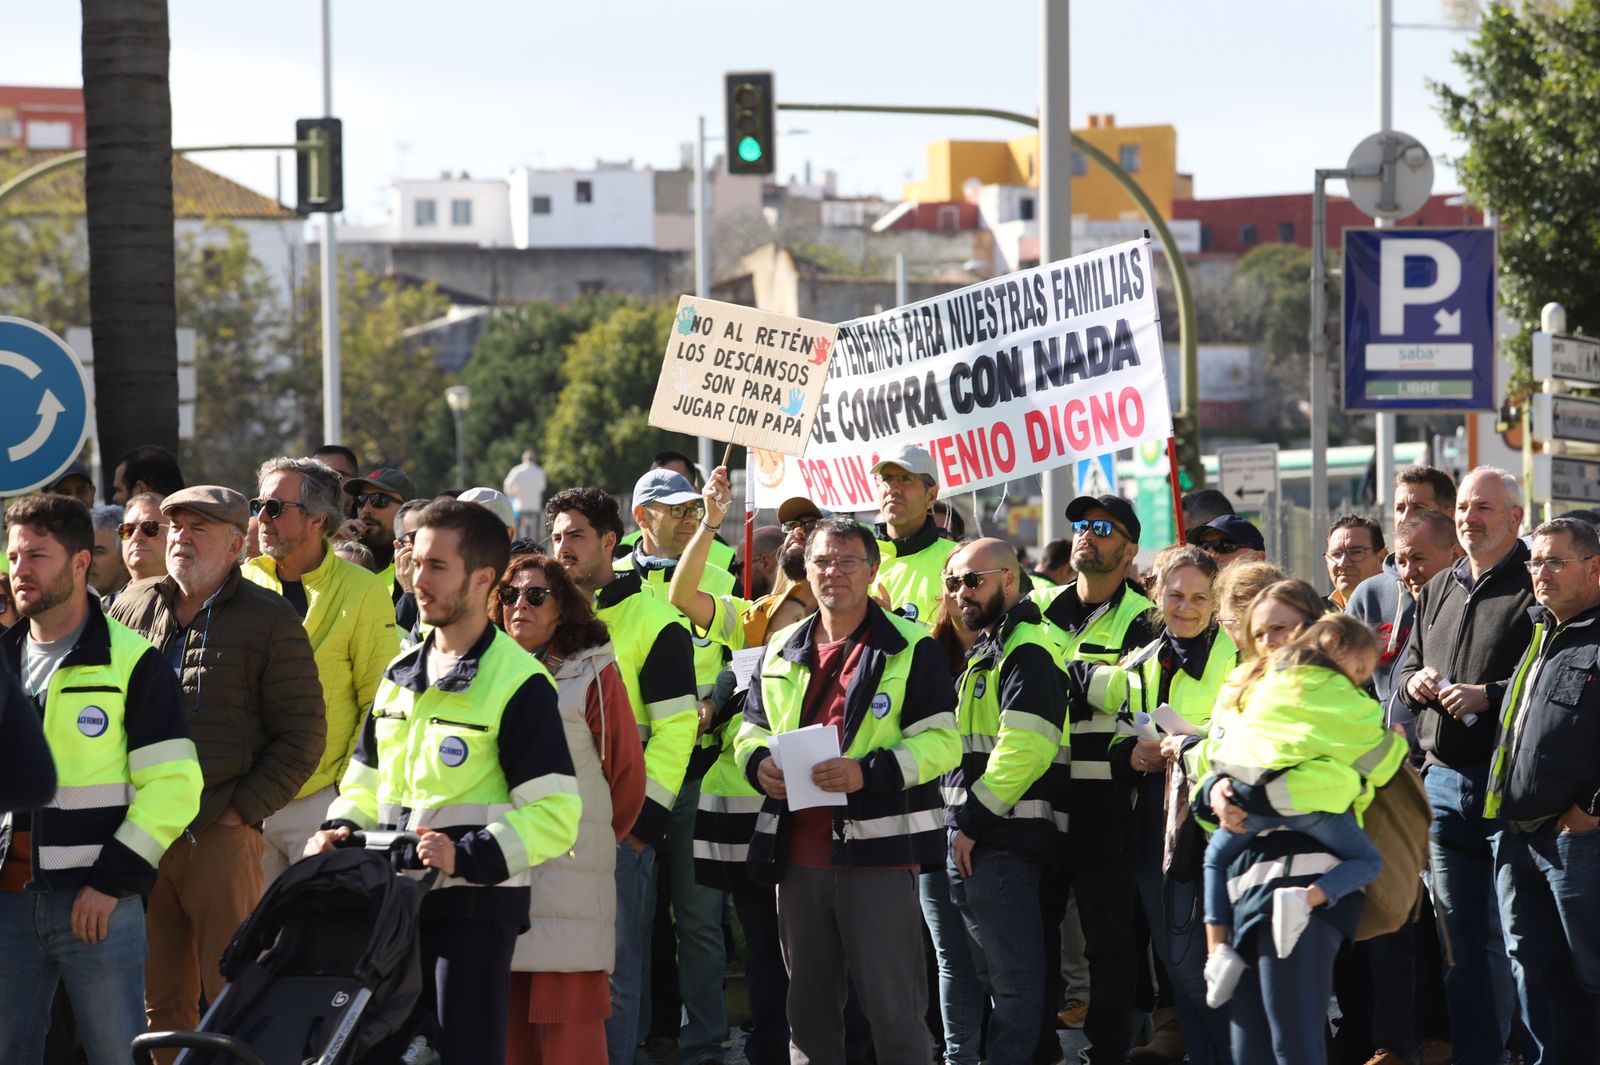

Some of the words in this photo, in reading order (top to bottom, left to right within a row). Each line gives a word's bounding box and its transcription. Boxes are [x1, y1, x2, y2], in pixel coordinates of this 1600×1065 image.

[1380, 238, 1462, 336] P
[690, 314, 713, 336] NO
[723, 321, 743, 342] AL
[755, 327, 814, 355] RETÉN
[838, 315, 904, 377] TENEMOS
[902, 303, 947, 362] PARA
[947, 273, 1048, 350] NUESTRAS
[1051, 247, 1145, 322] FAMILIAS
[676, 341, 706, 363] LOS
[713, 347, 810, 386] DESCANSOS
[837, 369, 948, 443] COMPRA
[949, 345, 1027, 415] CON
[1033, 318, 1142, 392] NADA
[702, 371, 736, 395] SON
[741, 380, 782, 406] PARA
[1398, 382, 1439, 396] LIBRE
[672, 394, 726, 421] JUGAR
[729, 404, 759, 427] CON
[761, 413, 805, 438] PAPÁ
[797, 458, 843, 506] POR
[833, 454, 875, 505] UN
[1024, 385, 1146, 464] DIGNO
